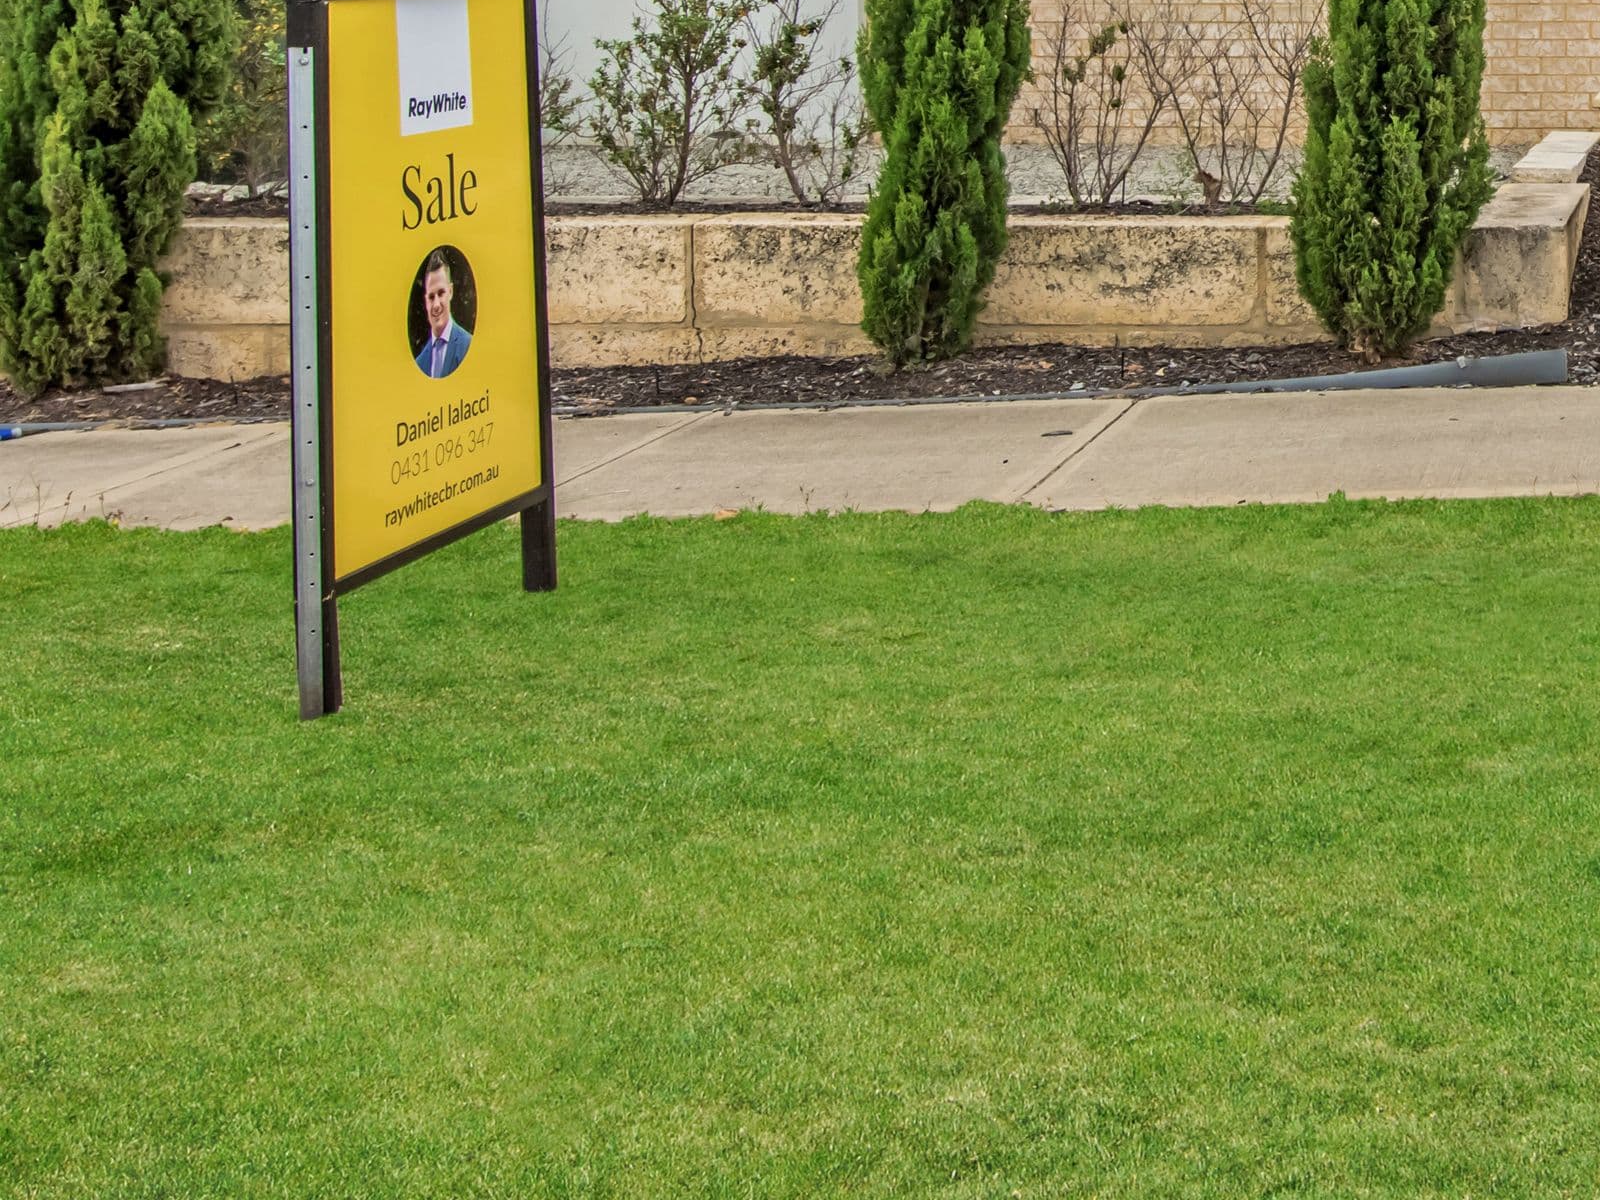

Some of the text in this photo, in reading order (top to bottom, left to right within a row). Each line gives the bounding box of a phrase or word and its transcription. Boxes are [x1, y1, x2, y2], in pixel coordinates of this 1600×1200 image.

[402, 153, 478, 231] Sale
[390, 422, 494, 485] 0431 096 347
[396, 407, 443, 447] Daniel
[385, 464, 499, 528] raywhitecbr.com.au
